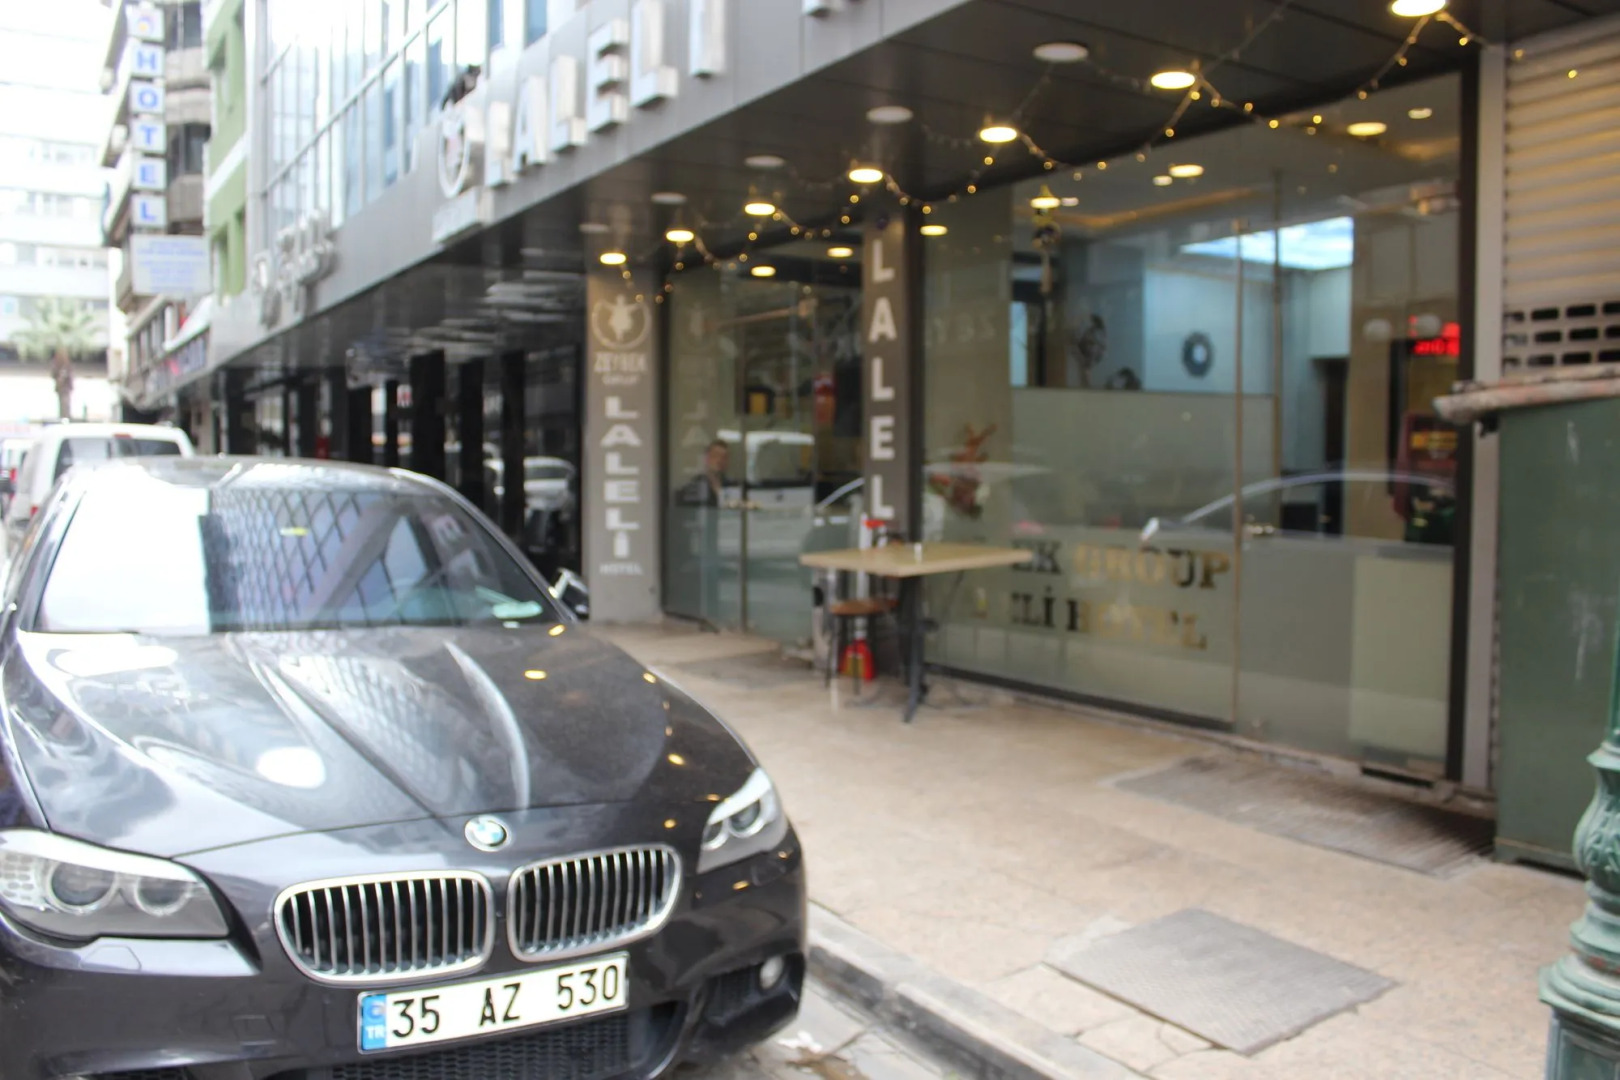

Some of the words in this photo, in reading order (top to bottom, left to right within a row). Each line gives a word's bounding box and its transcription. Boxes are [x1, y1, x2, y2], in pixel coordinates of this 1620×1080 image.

[137, 52, 159, 222] HOTEL
[365, 1025, 386, 1040] TR
[393, 994, 440, 1038] 35
[478, 982, 521, 1026] AZ
[557, 965, 618, 1010] 530
